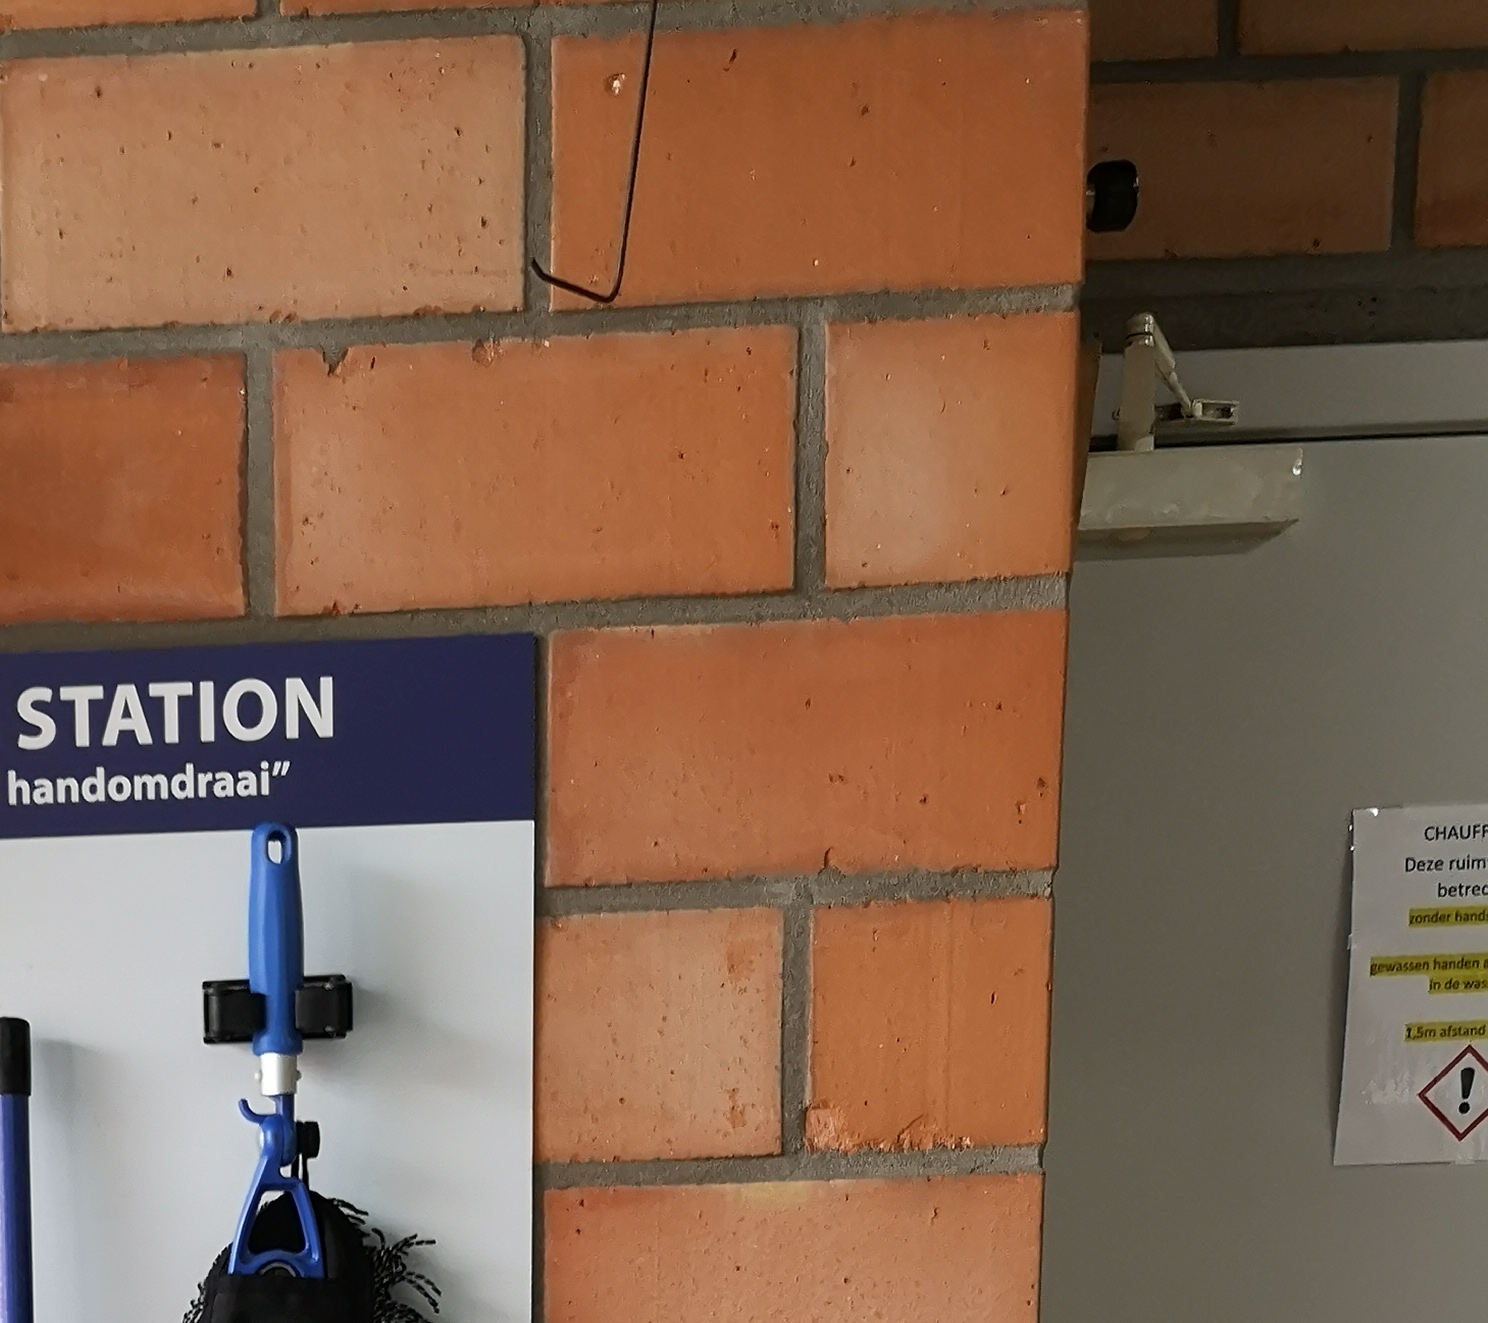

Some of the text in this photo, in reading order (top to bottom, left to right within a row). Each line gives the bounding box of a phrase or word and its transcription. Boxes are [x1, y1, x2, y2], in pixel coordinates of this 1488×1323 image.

[16, 676, 334, 750] STATION
[1405, 853, 1488, 873] Deze ruim
[1409, 911, 1451, 926] zonder
[1370, 962, 1430, 976] gewassen
[1432, 956, 1480, 970] handen
[1429, 978, 1442, 992] in
[1444, 978, 1460, 990] de
[1406, 1024, 1486, 1039] 1,5m afstand
